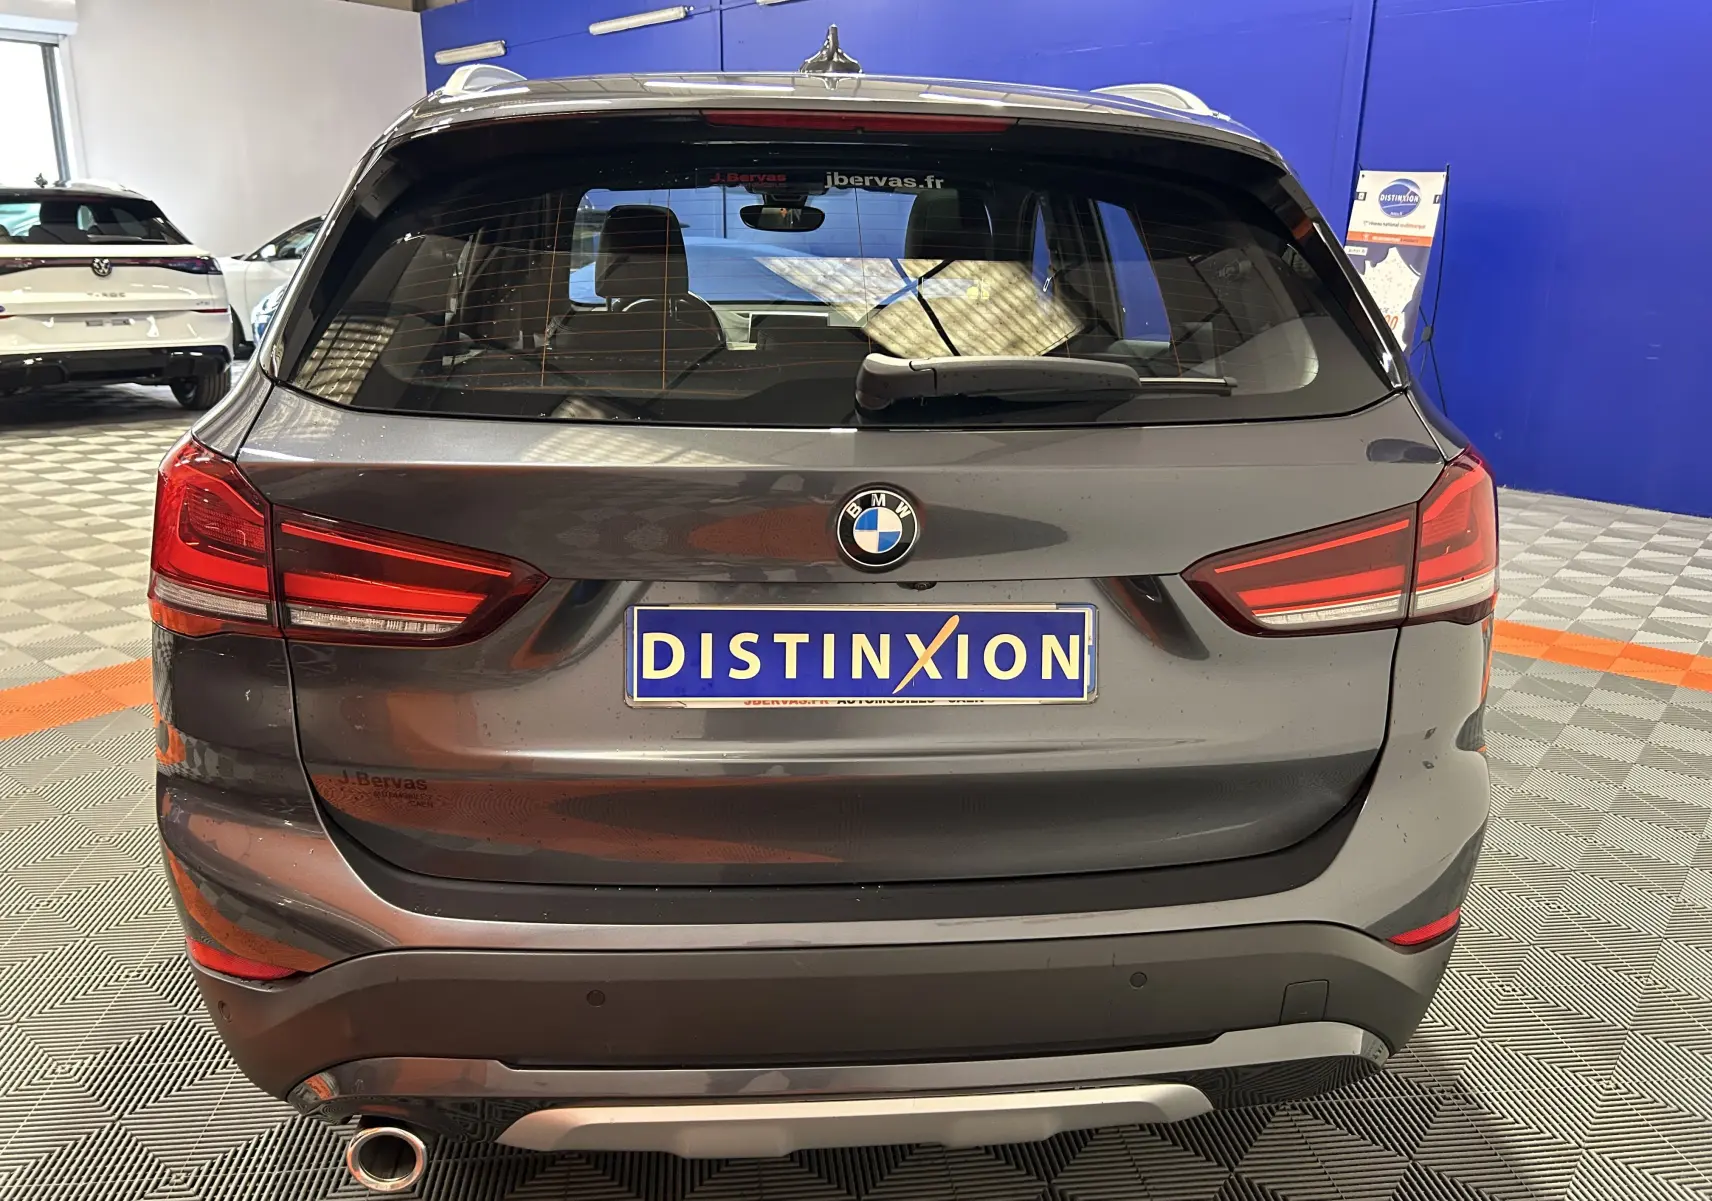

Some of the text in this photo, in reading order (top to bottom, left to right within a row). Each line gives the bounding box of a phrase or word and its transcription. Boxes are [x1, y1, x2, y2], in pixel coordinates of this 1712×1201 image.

[824, 171, 944, 189] jbervas.fr
[1380, 193, 1419, 203] DISTINXION
[846, 493, 912, 519] BMW
[641, 615, 1080, 694] DISTINXION
[338, 769, 428, 791] J.Bervas
